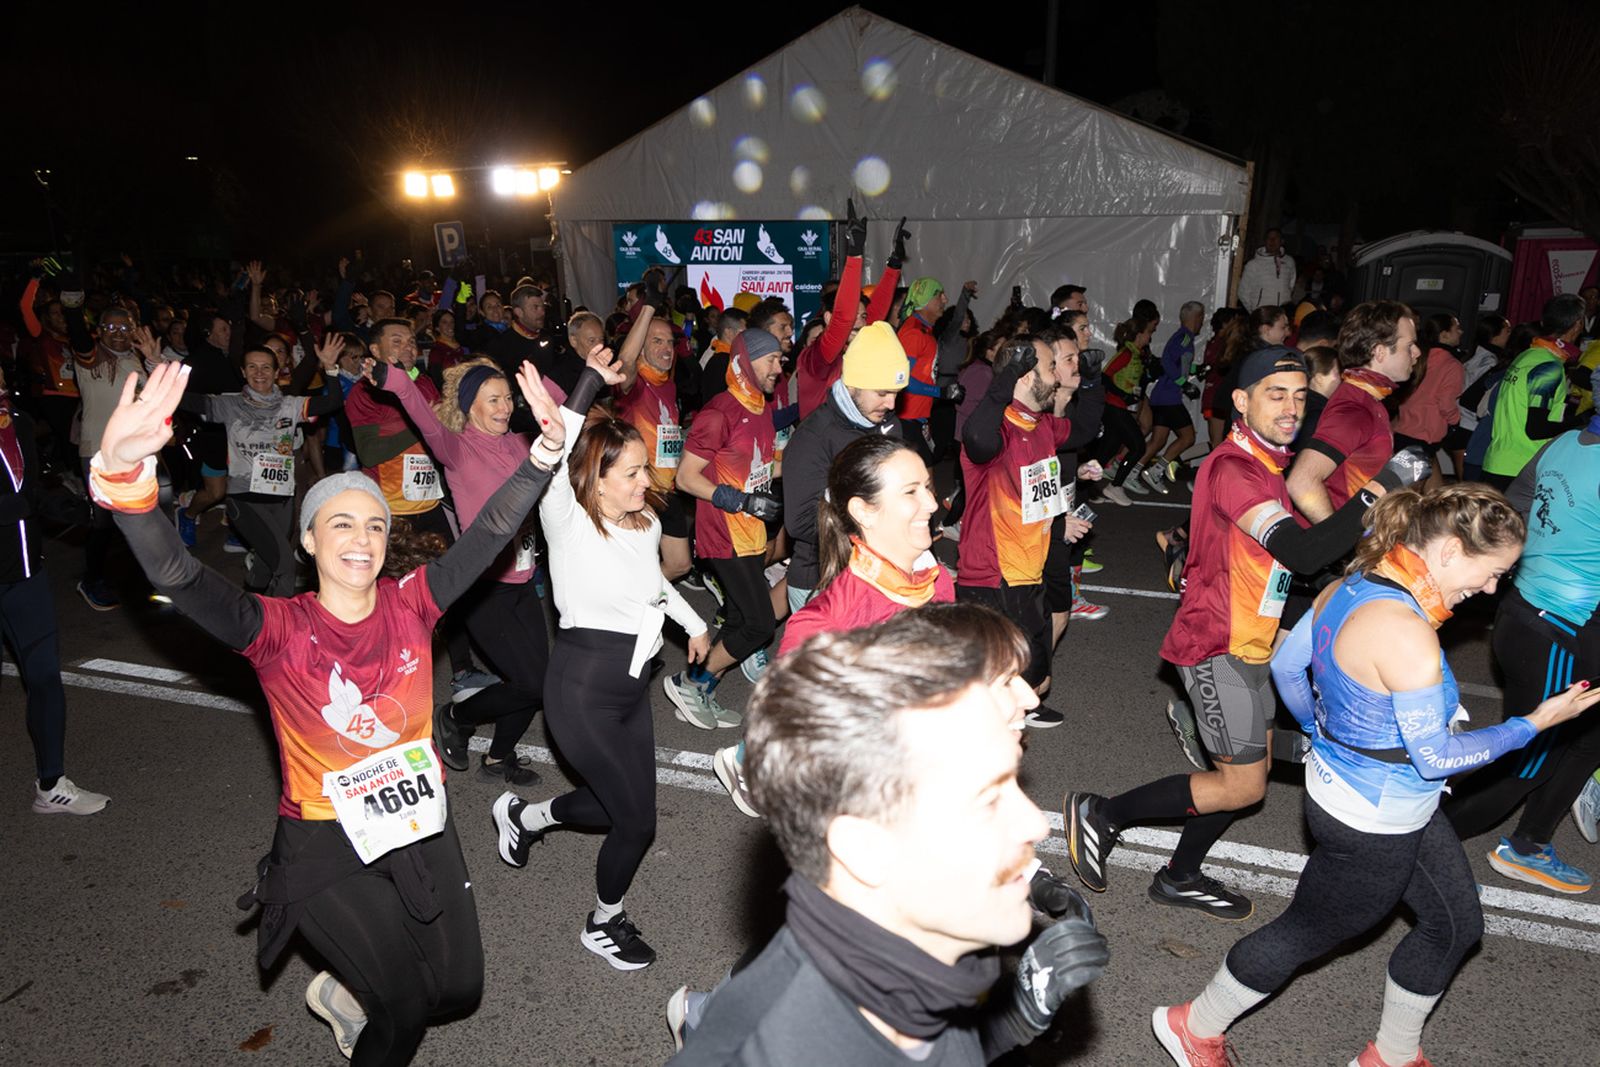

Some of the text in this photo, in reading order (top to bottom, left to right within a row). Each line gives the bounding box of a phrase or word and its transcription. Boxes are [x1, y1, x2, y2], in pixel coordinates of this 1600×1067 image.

[441, 227, 460, 253] P
[694, 228, 745, 245] 43 SAN
[661, 245, 673, 258] 43
[690, 243, 743, 261] ANTÓN
[764, 245, 775, 258] 43
[740, 281, 765, 293] SAN
[261, 468, 289, 482] 4065
[346, 713, 376, 740] 43
[352, 763, 386, 785] NOCHE
[385, 758, 399, 769] DE
[345, 768, 405, 800] SAN ANTÓN
[363, 773, 435, 821] 4664
